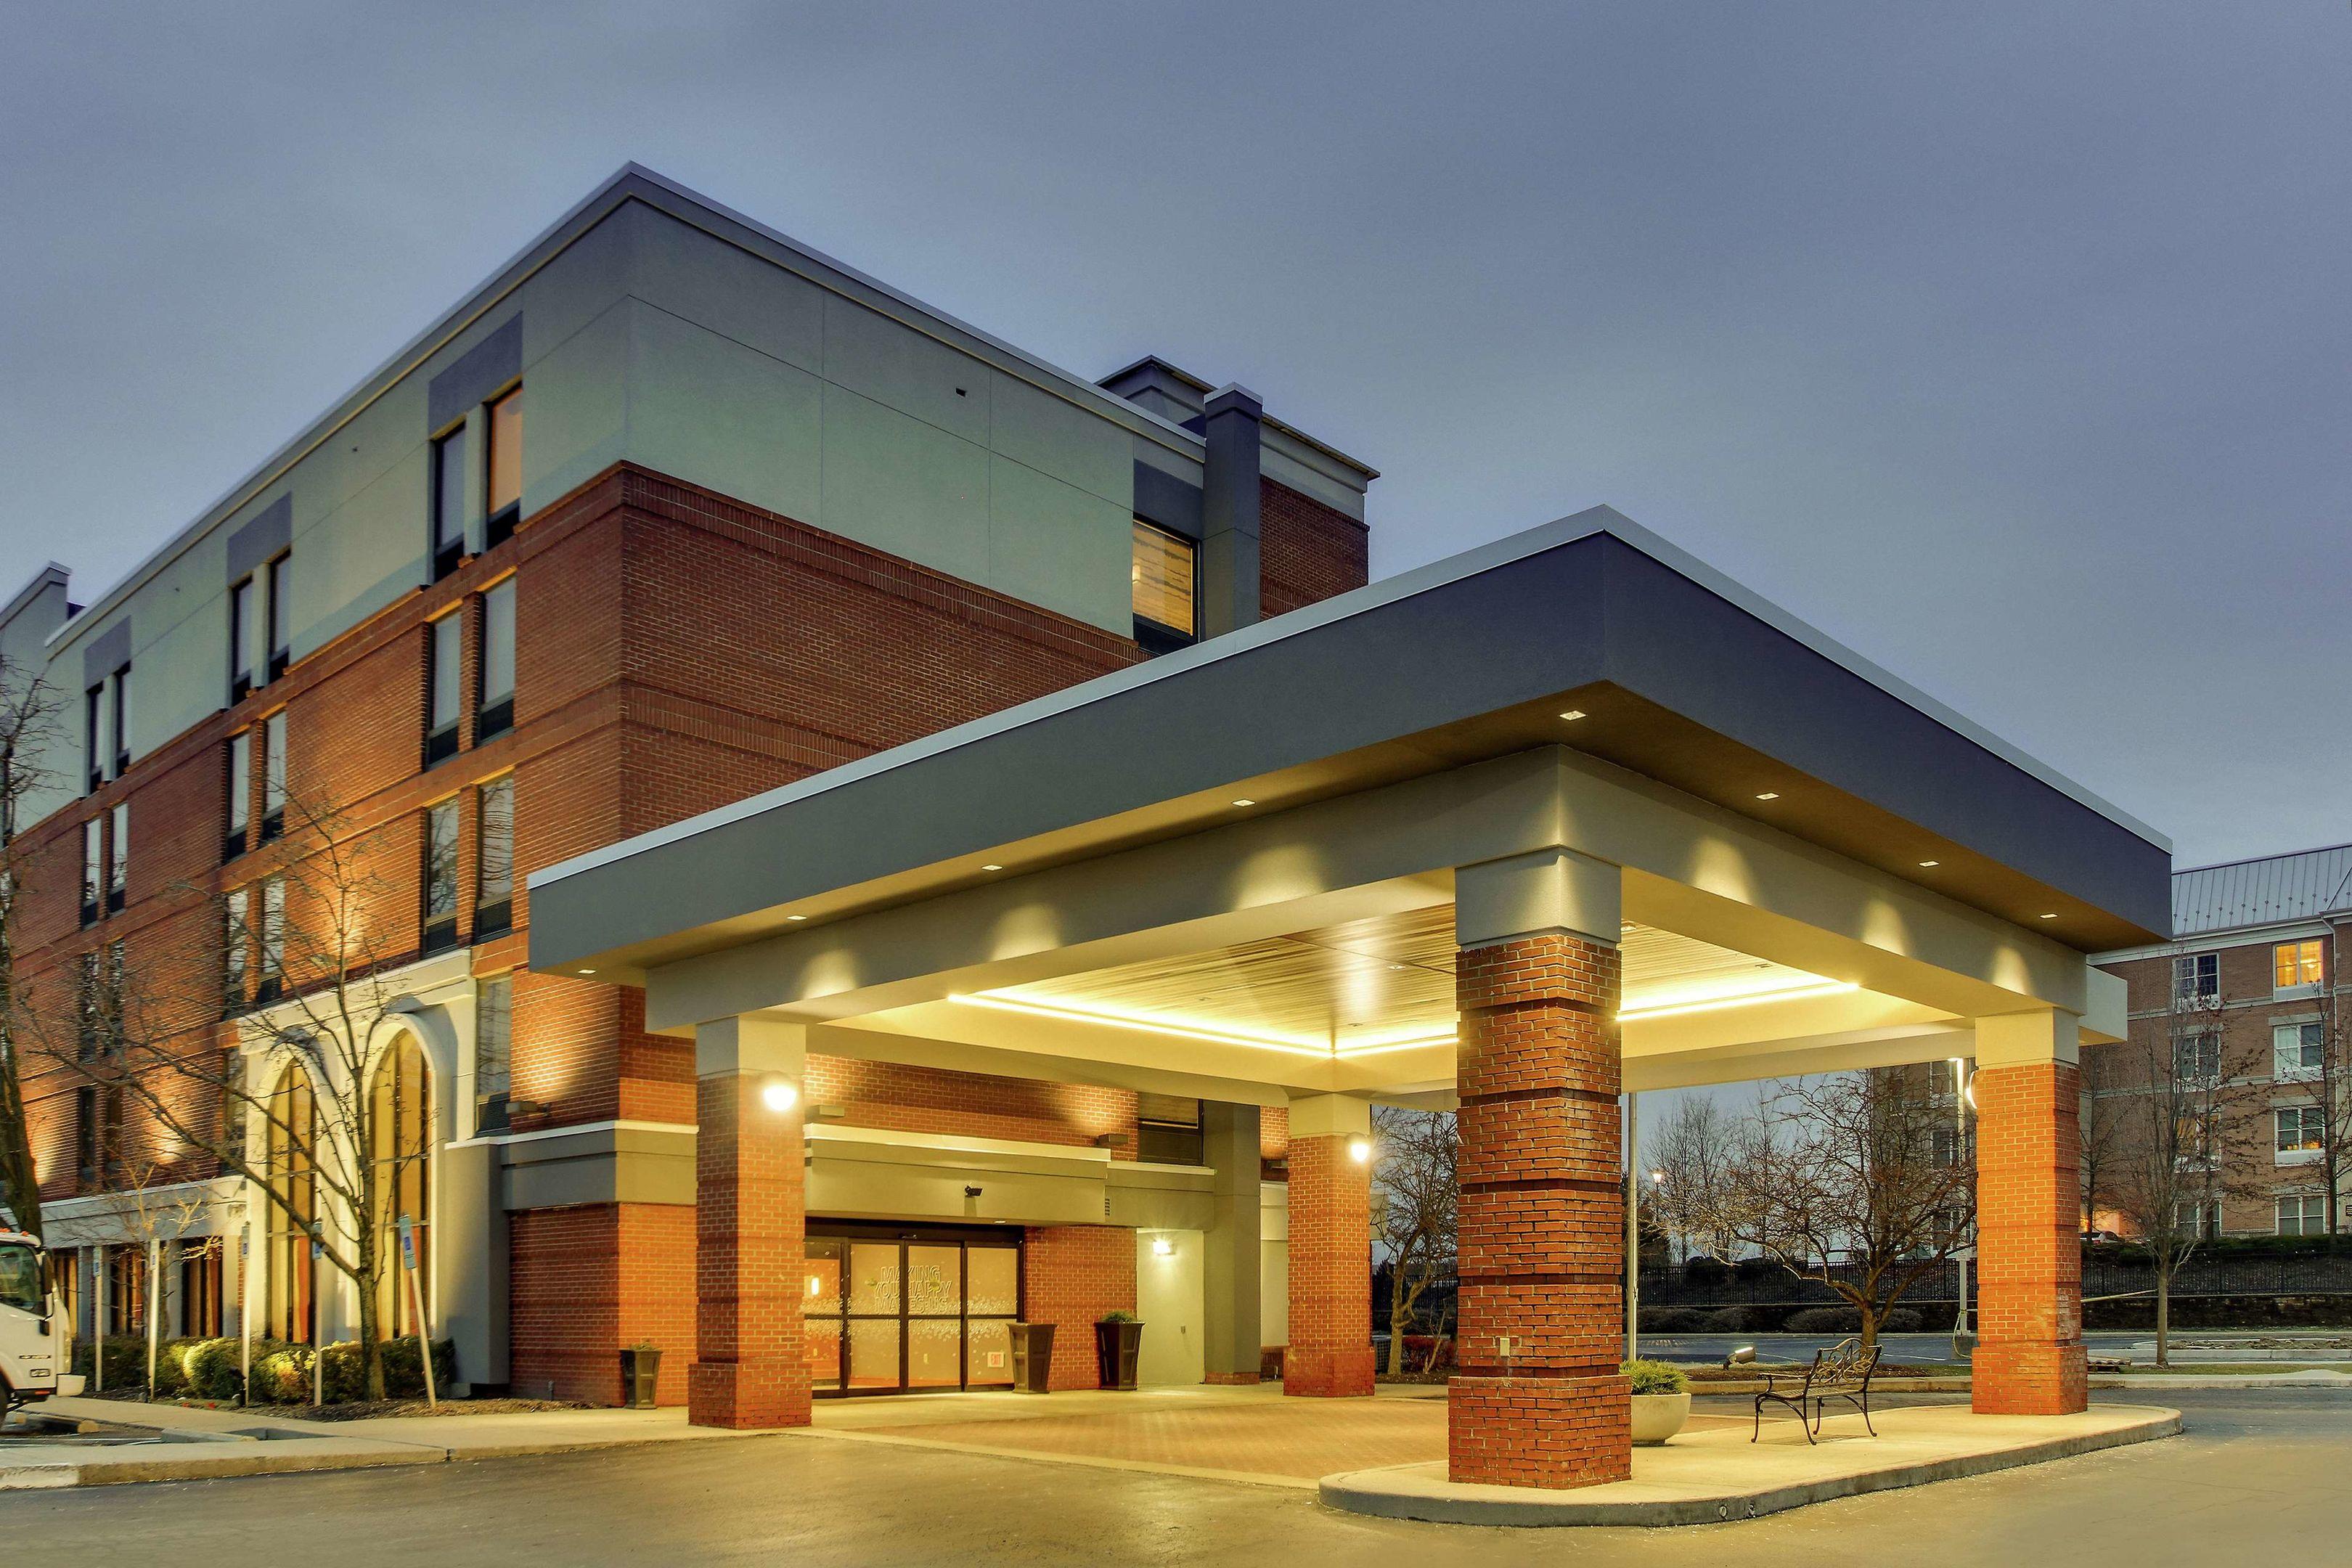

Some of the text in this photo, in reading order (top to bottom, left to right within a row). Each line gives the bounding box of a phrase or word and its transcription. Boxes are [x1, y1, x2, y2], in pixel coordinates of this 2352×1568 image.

[875, 1281, 952, 1298] YOU HAPPY
[874, 1297, 926, 1315] MAES
